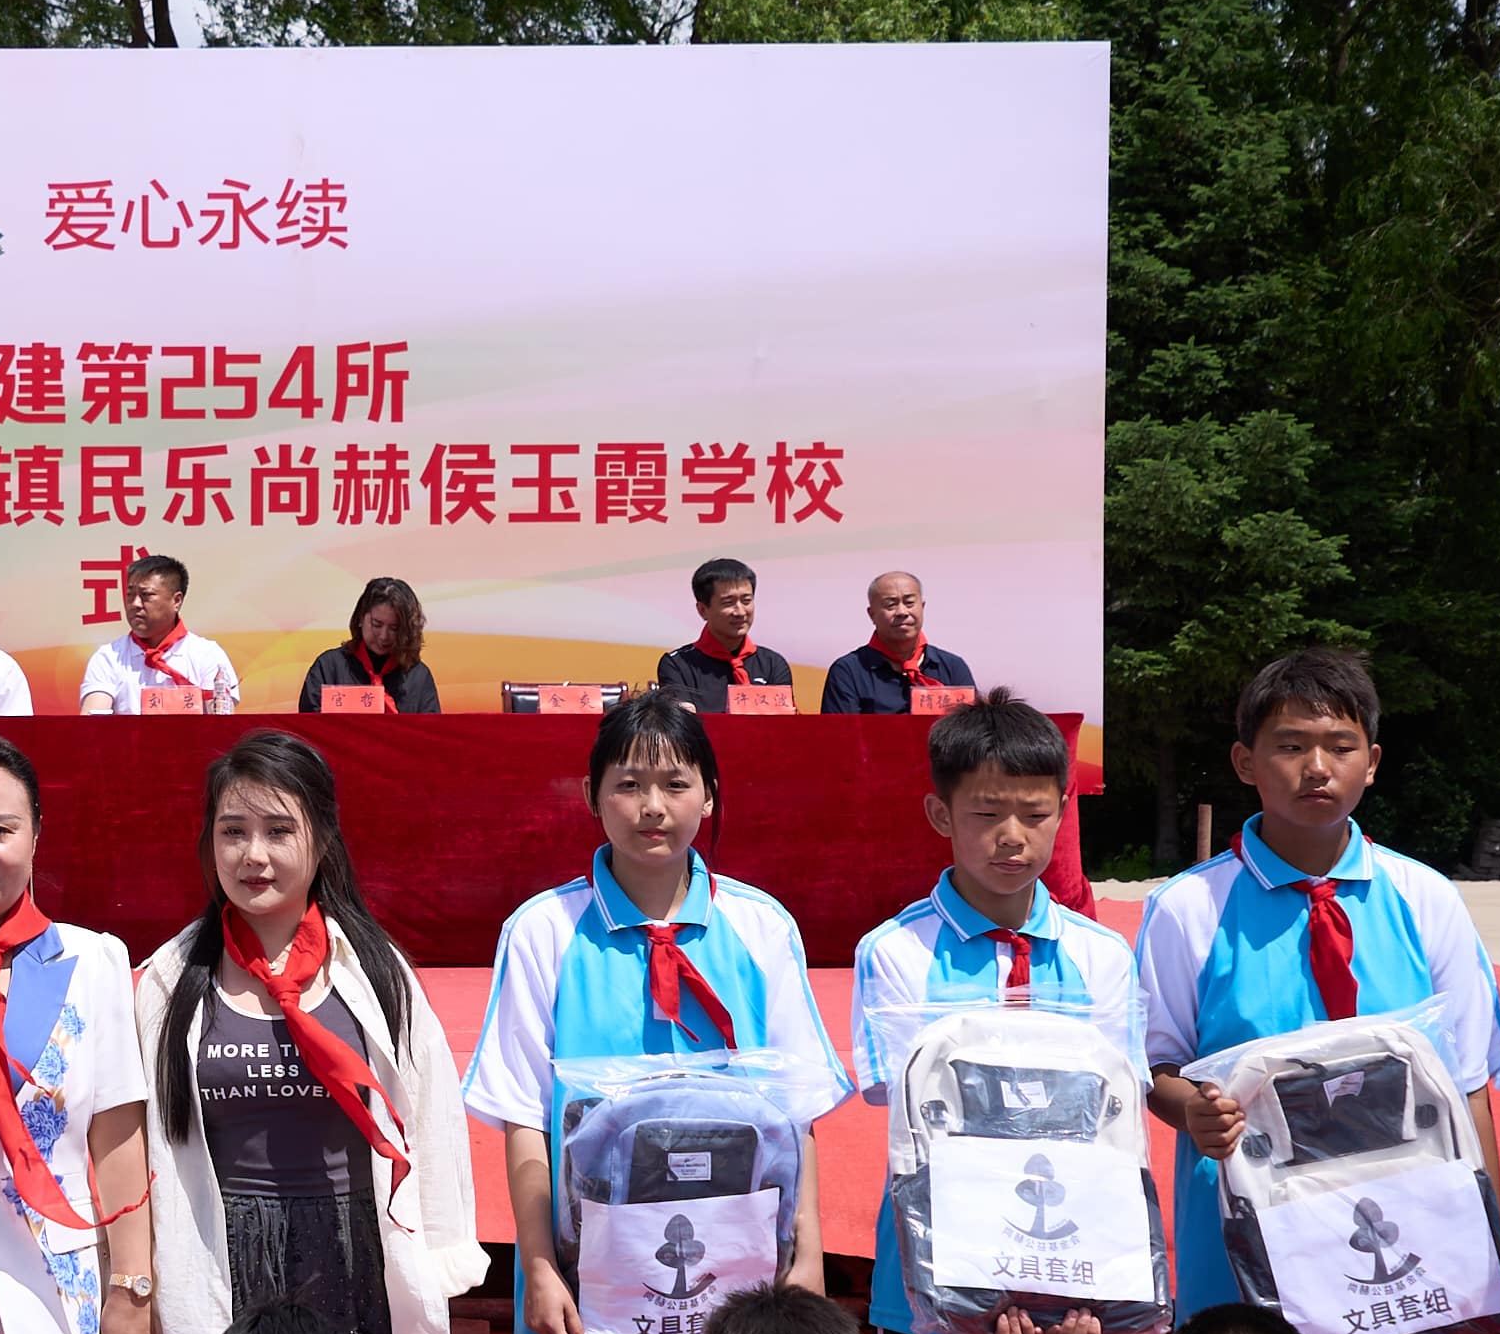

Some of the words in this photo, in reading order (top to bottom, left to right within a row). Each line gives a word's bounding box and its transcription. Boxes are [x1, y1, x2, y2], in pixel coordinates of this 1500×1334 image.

[46, 179, 348, 249] 爱心永续
[207, 1043, 270, 1058] MORE
[247, 1064, 299, 1078] LESS
[201, 1085, 257, 1101] THAN
[991, 1254, 1096, 1287] 文具套组
